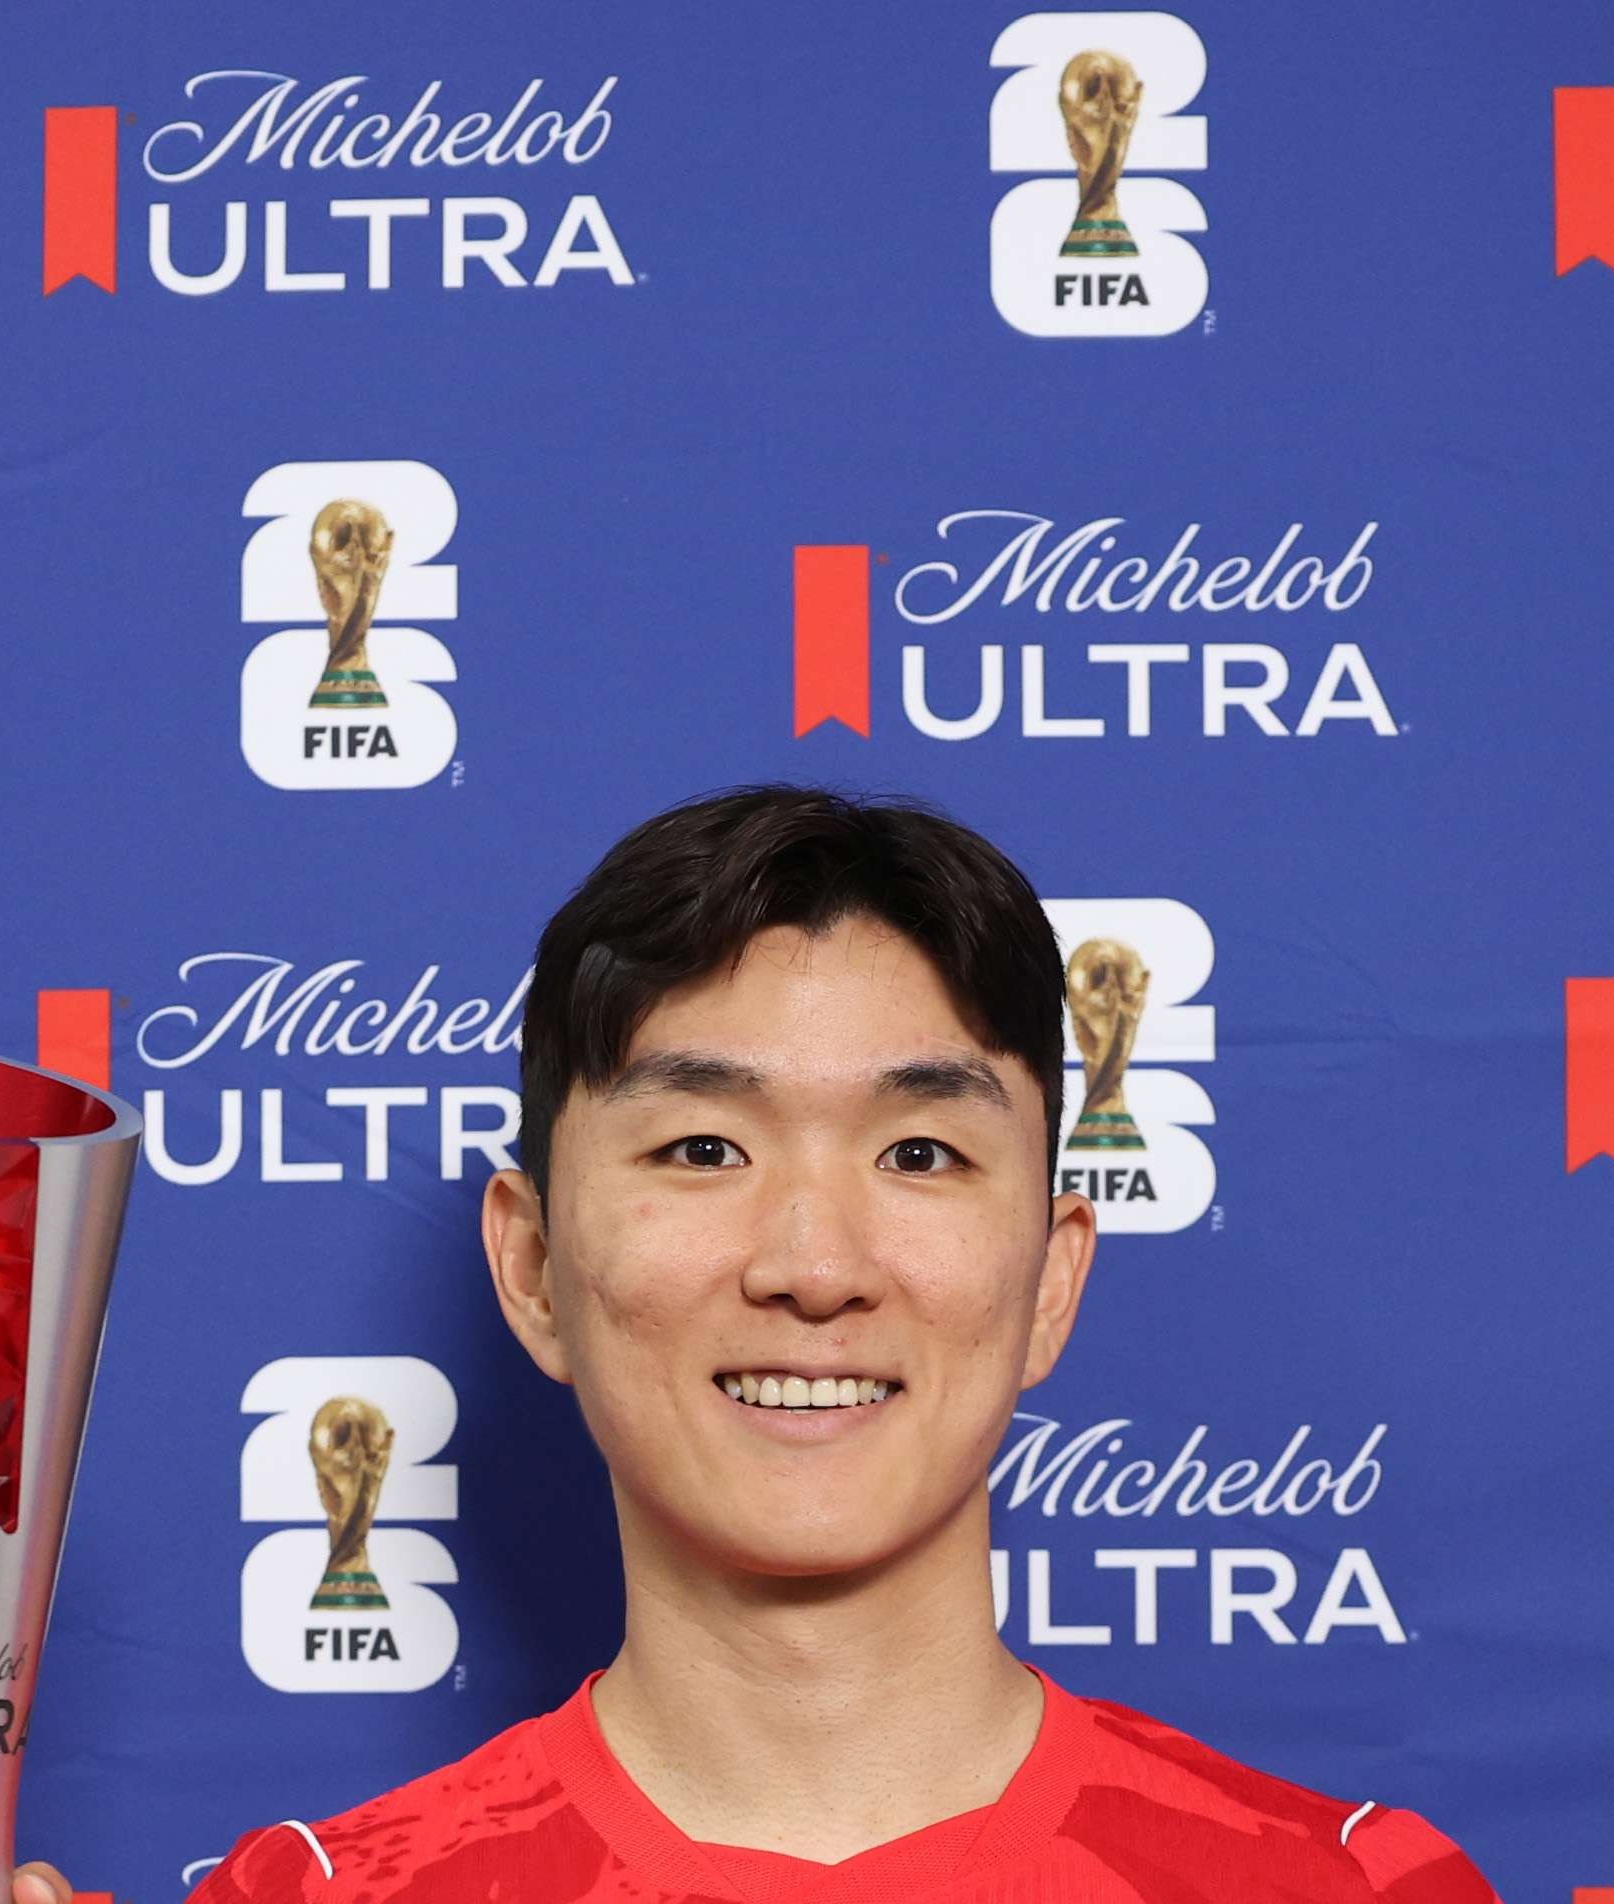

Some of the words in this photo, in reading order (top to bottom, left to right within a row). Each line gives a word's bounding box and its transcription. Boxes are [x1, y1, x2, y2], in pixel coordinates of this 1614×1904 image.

[143, 70, 617, 182] Michelob
[149, 195, 635, 296] ULTRA
[1055, 274, 1149, 307] FIFA
[894, 510, 1378, 624] Michelob
[903, 644, 1398, 740] ULTRA
[304, 725, 398, 759] FIFA
[137, 952, 536, 1069] Michel
[144, 1087, 523, 1185] ULTR
[1059, 1168, 1158, 1203] FIFA
[305, 1628, 400, 1661] FIFA
